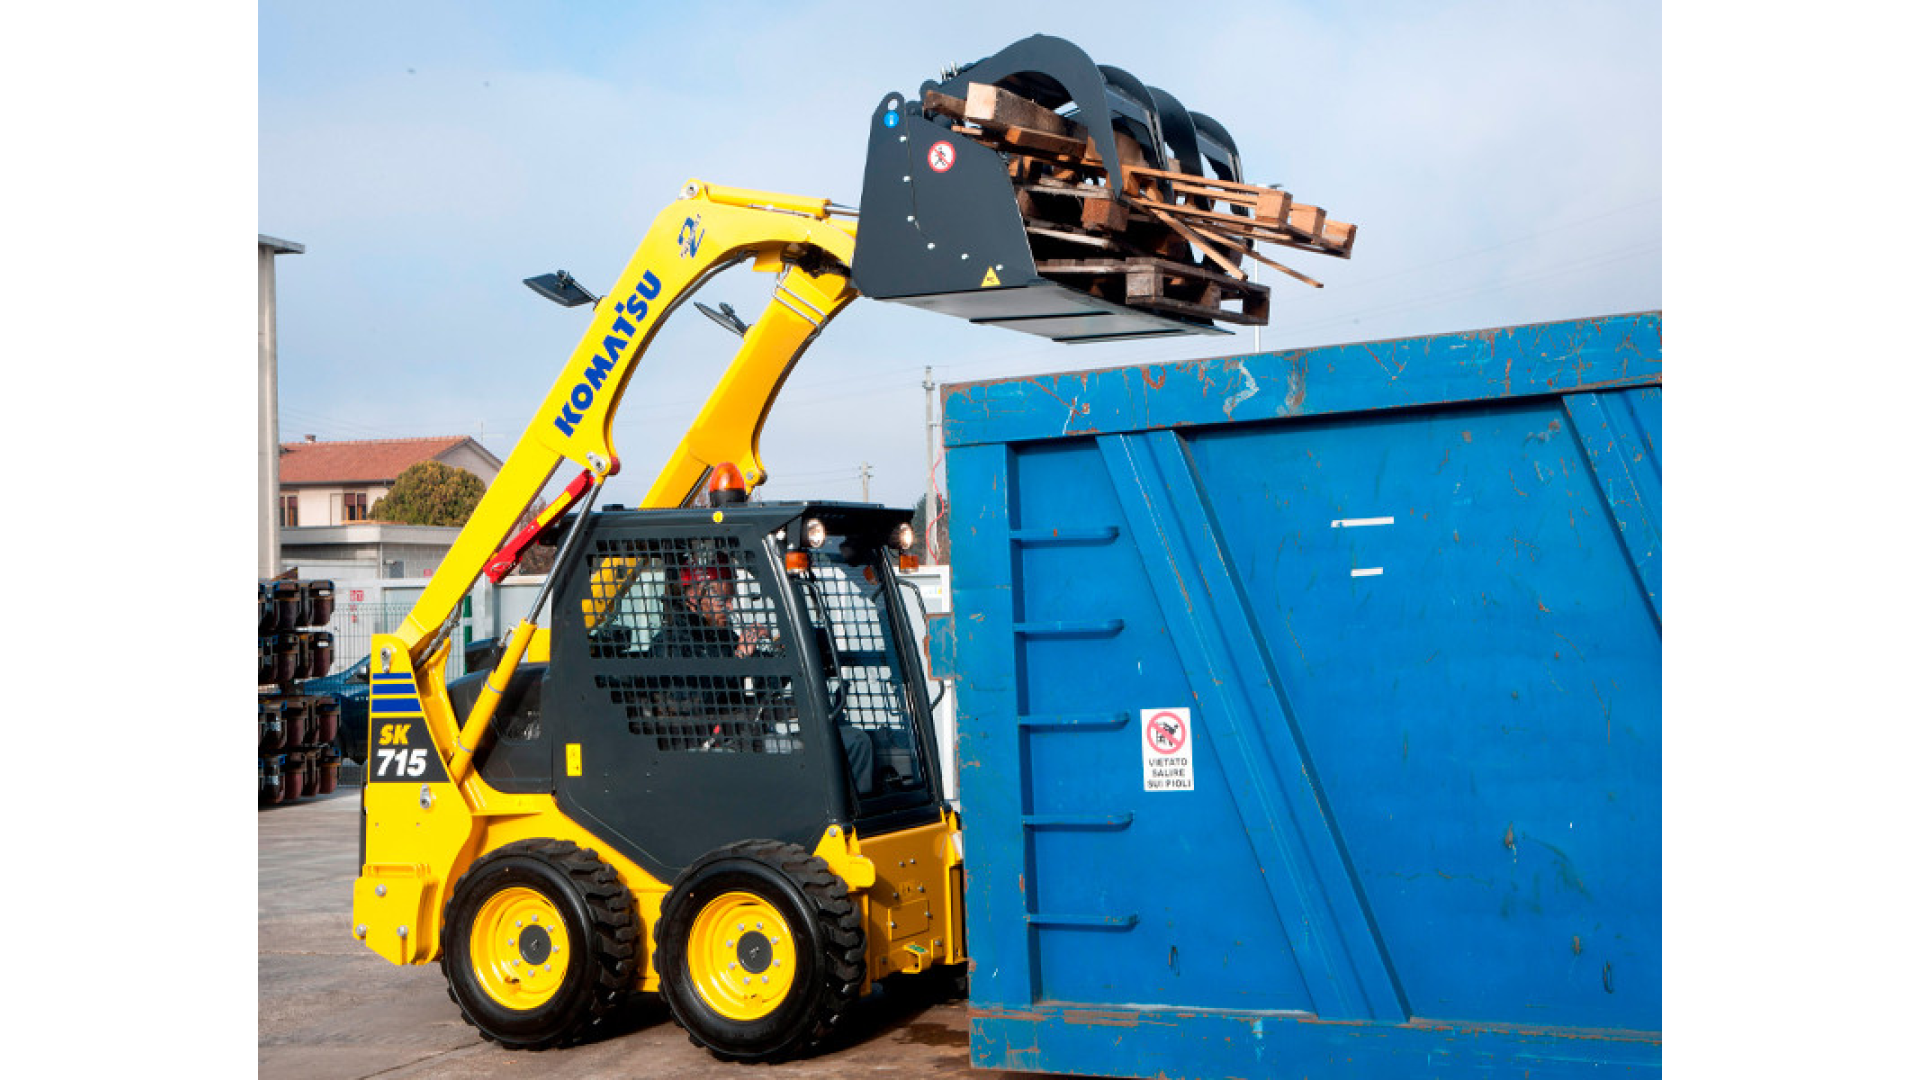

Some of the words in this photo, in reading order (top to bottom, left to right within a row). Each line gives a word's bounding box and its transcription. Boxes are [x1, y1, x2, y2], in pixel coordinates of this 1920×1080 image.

[554, 269, 662, 438] KOMATSU
[378, 723, 411, 745] SK
[376, 748, 428, 777] 715
[1148, 757, 1188, 767] VIETATO
[1152, 768, 1185, 778] SALIRE
[1165, 779, 1191, 788] PIOLI
